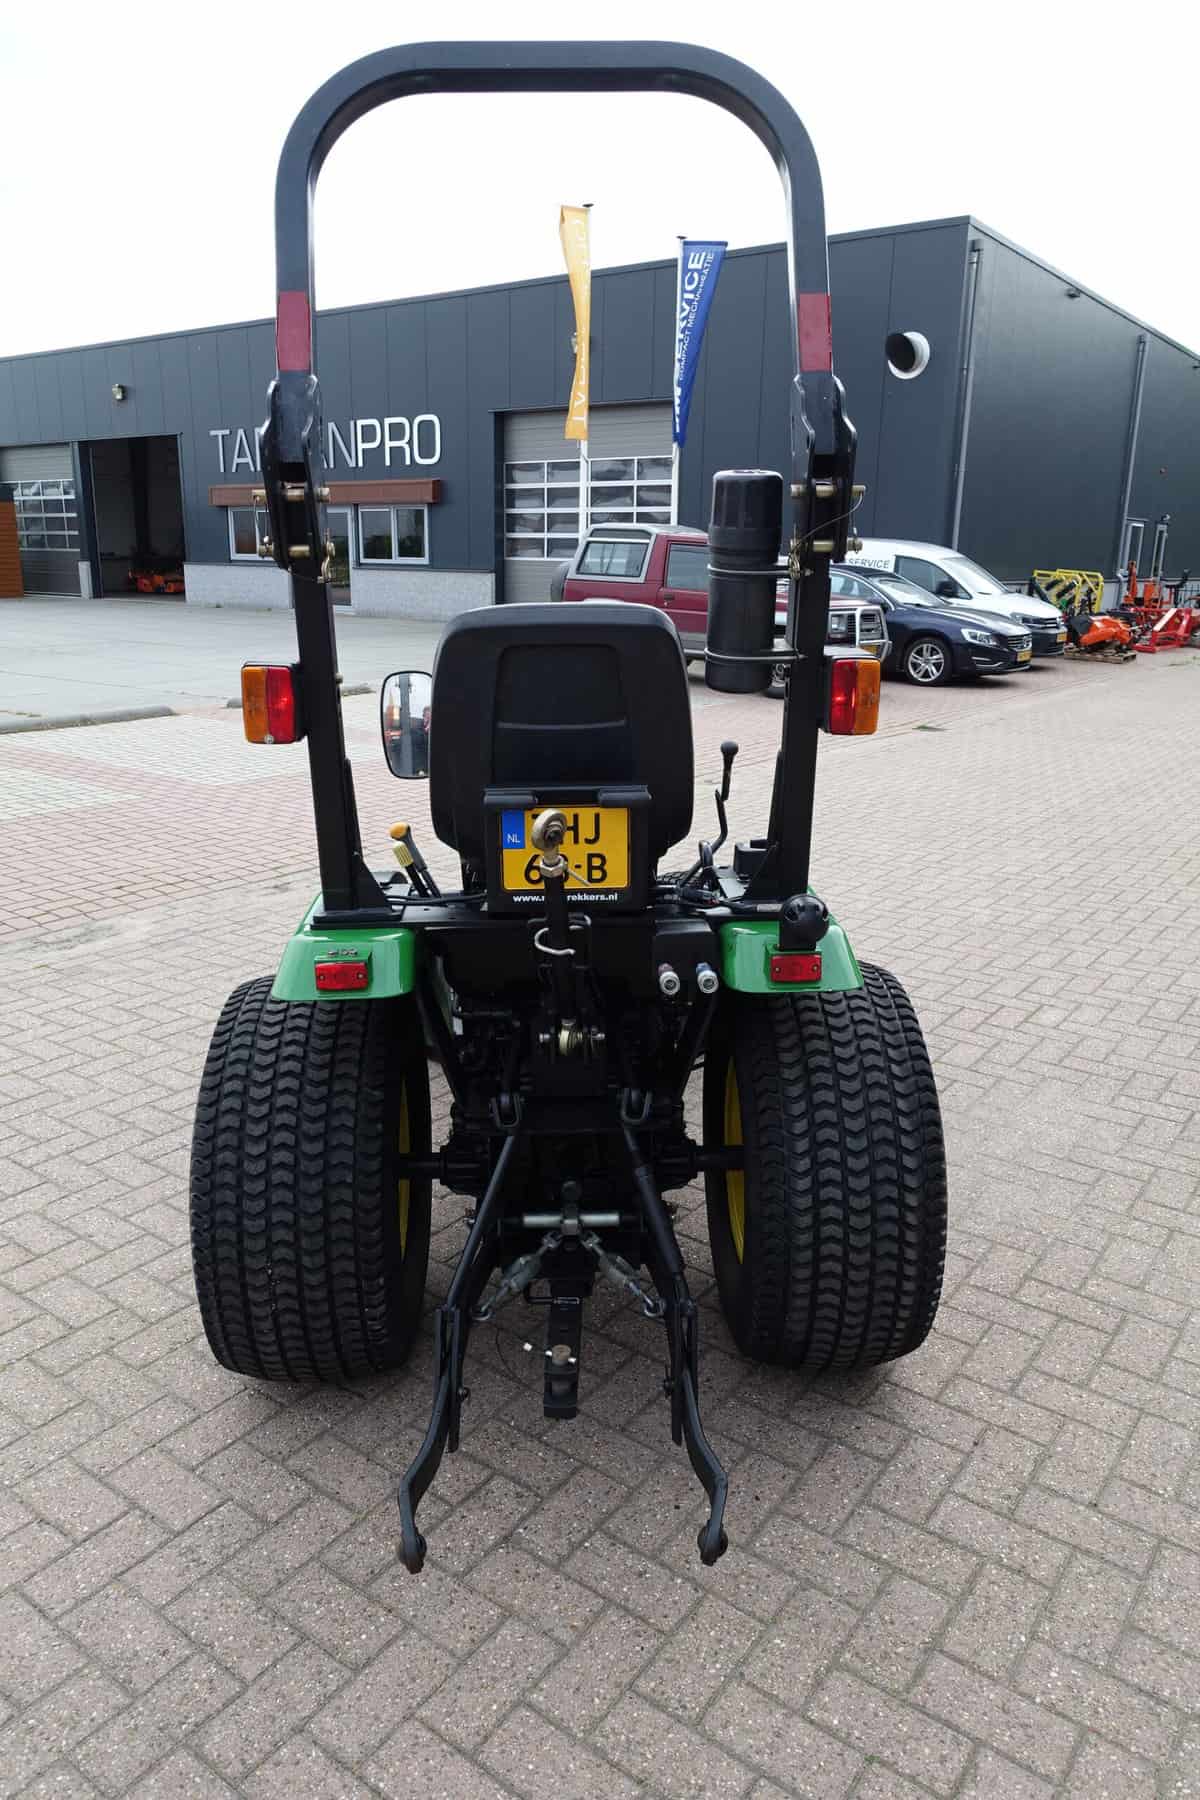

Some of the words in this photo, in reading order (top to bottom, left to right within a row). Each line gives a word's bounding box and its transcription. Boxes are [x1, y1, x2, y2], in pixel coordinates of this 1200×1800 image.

[848, 559, 889, 569] SERVICE
[532, 813, 600, 845] HJ
[507, 833, 520, 843] NL
